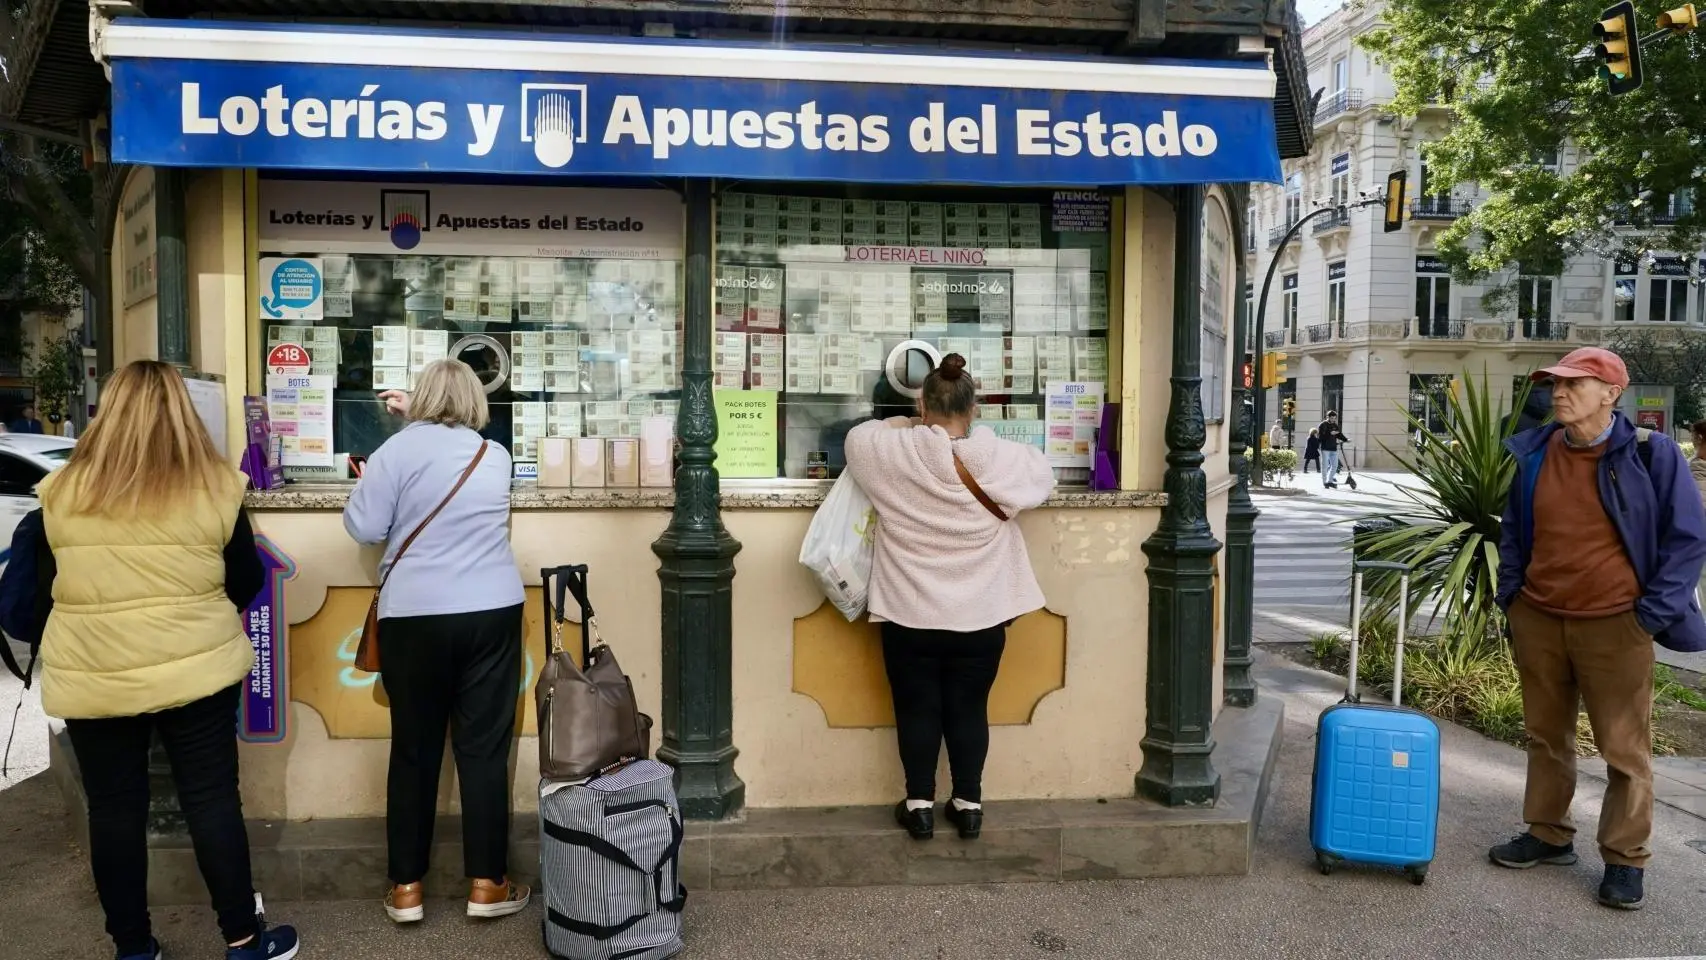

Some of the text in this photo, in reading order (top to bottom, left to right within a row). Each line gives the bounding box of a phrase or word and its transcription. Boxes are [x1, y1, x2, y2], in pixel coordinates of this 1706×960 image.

[181, 83, 1218, 160] Loterías y Apuestas del Estado
[269, 209, 644, 231] Loterías y Apuestas del Estado
[943, 248, 984, 264] NIÑO
[276, 347, 300, 361] +18
[288, 378, 310, 387] BOTES
[1065, 384, 1085, 393] BOTES
[250, 611, 260, 632] MES
[259, 605, 270, 633] AÑOS
[251, 634, 260, 647] AL
[261, 635, 270, 649] 30
[261, 650, 271, 698] DURANTE
